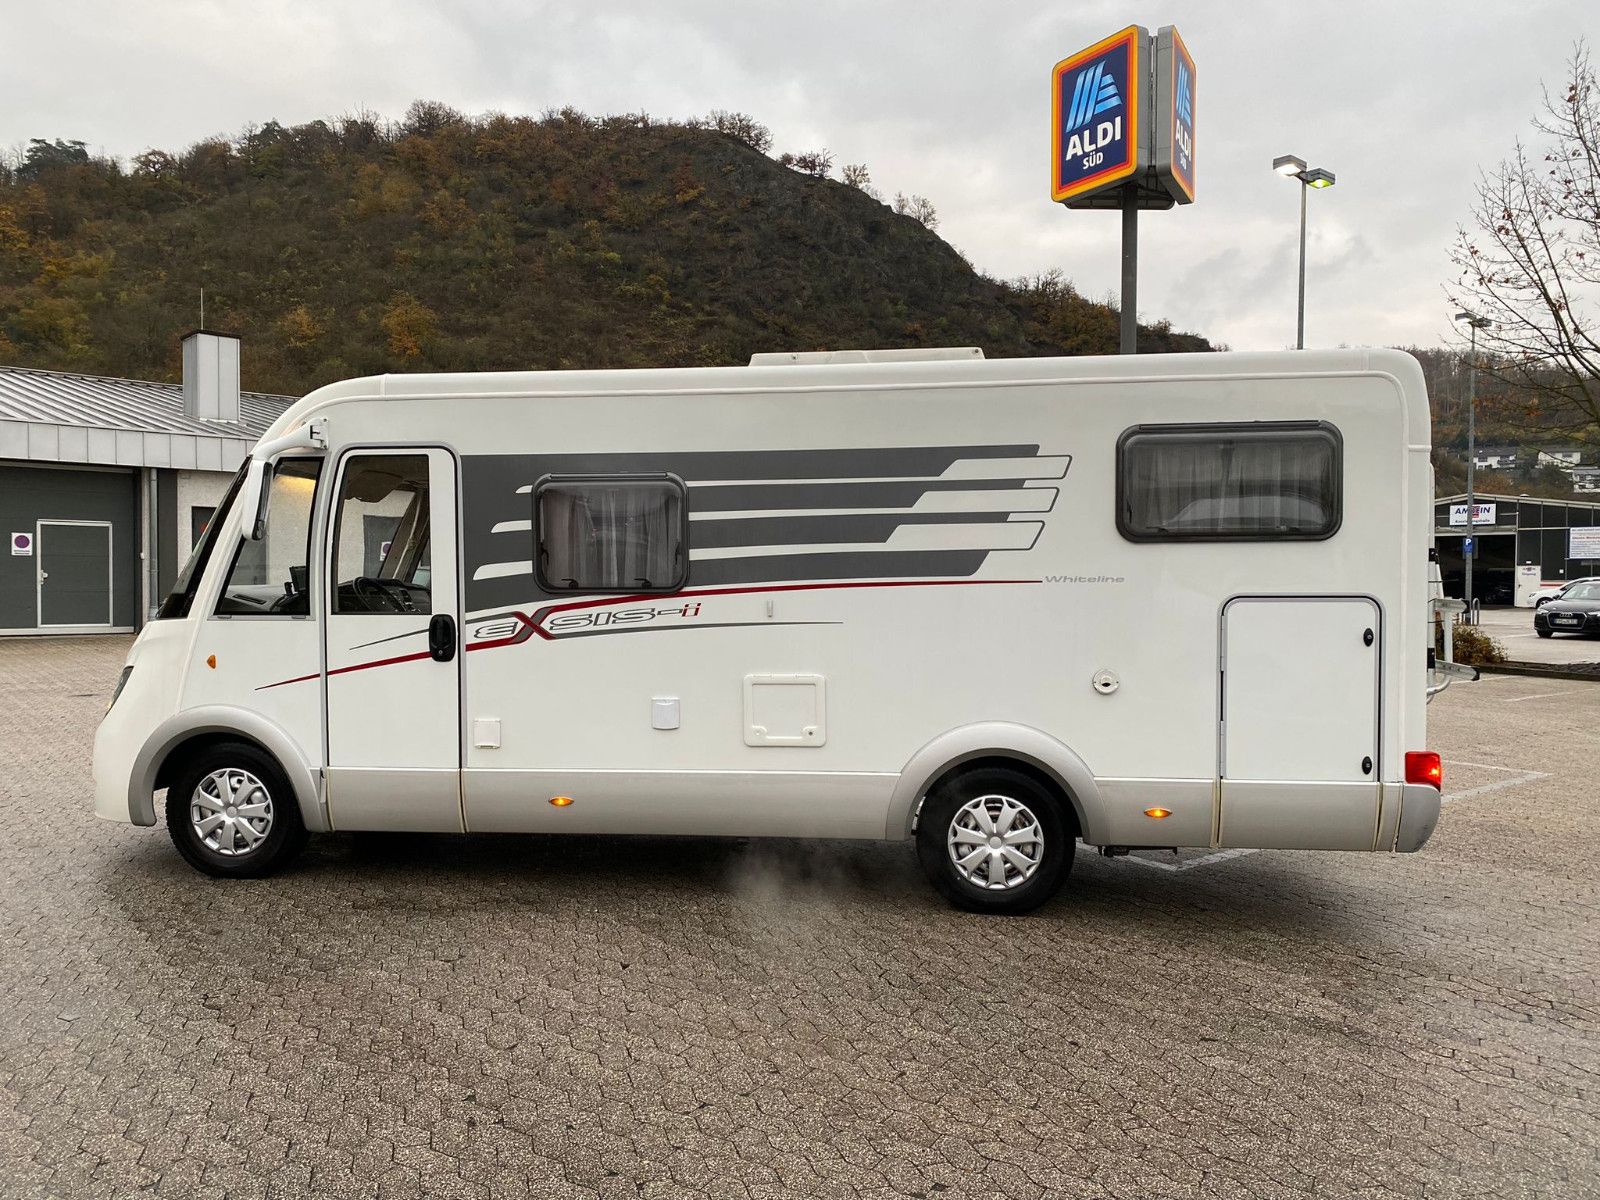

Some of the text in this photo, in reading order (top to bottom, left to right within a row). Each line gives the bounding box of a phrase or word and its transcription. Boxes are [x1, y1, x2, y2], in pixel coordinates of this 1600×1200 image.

[1065, 116, 1122, 161] ALDI
[1175, 118, 1192, 161] ALDI
[1082, 152, 1104, 170] SÜD
[1044, 575, 1125, 583] Whiteline
